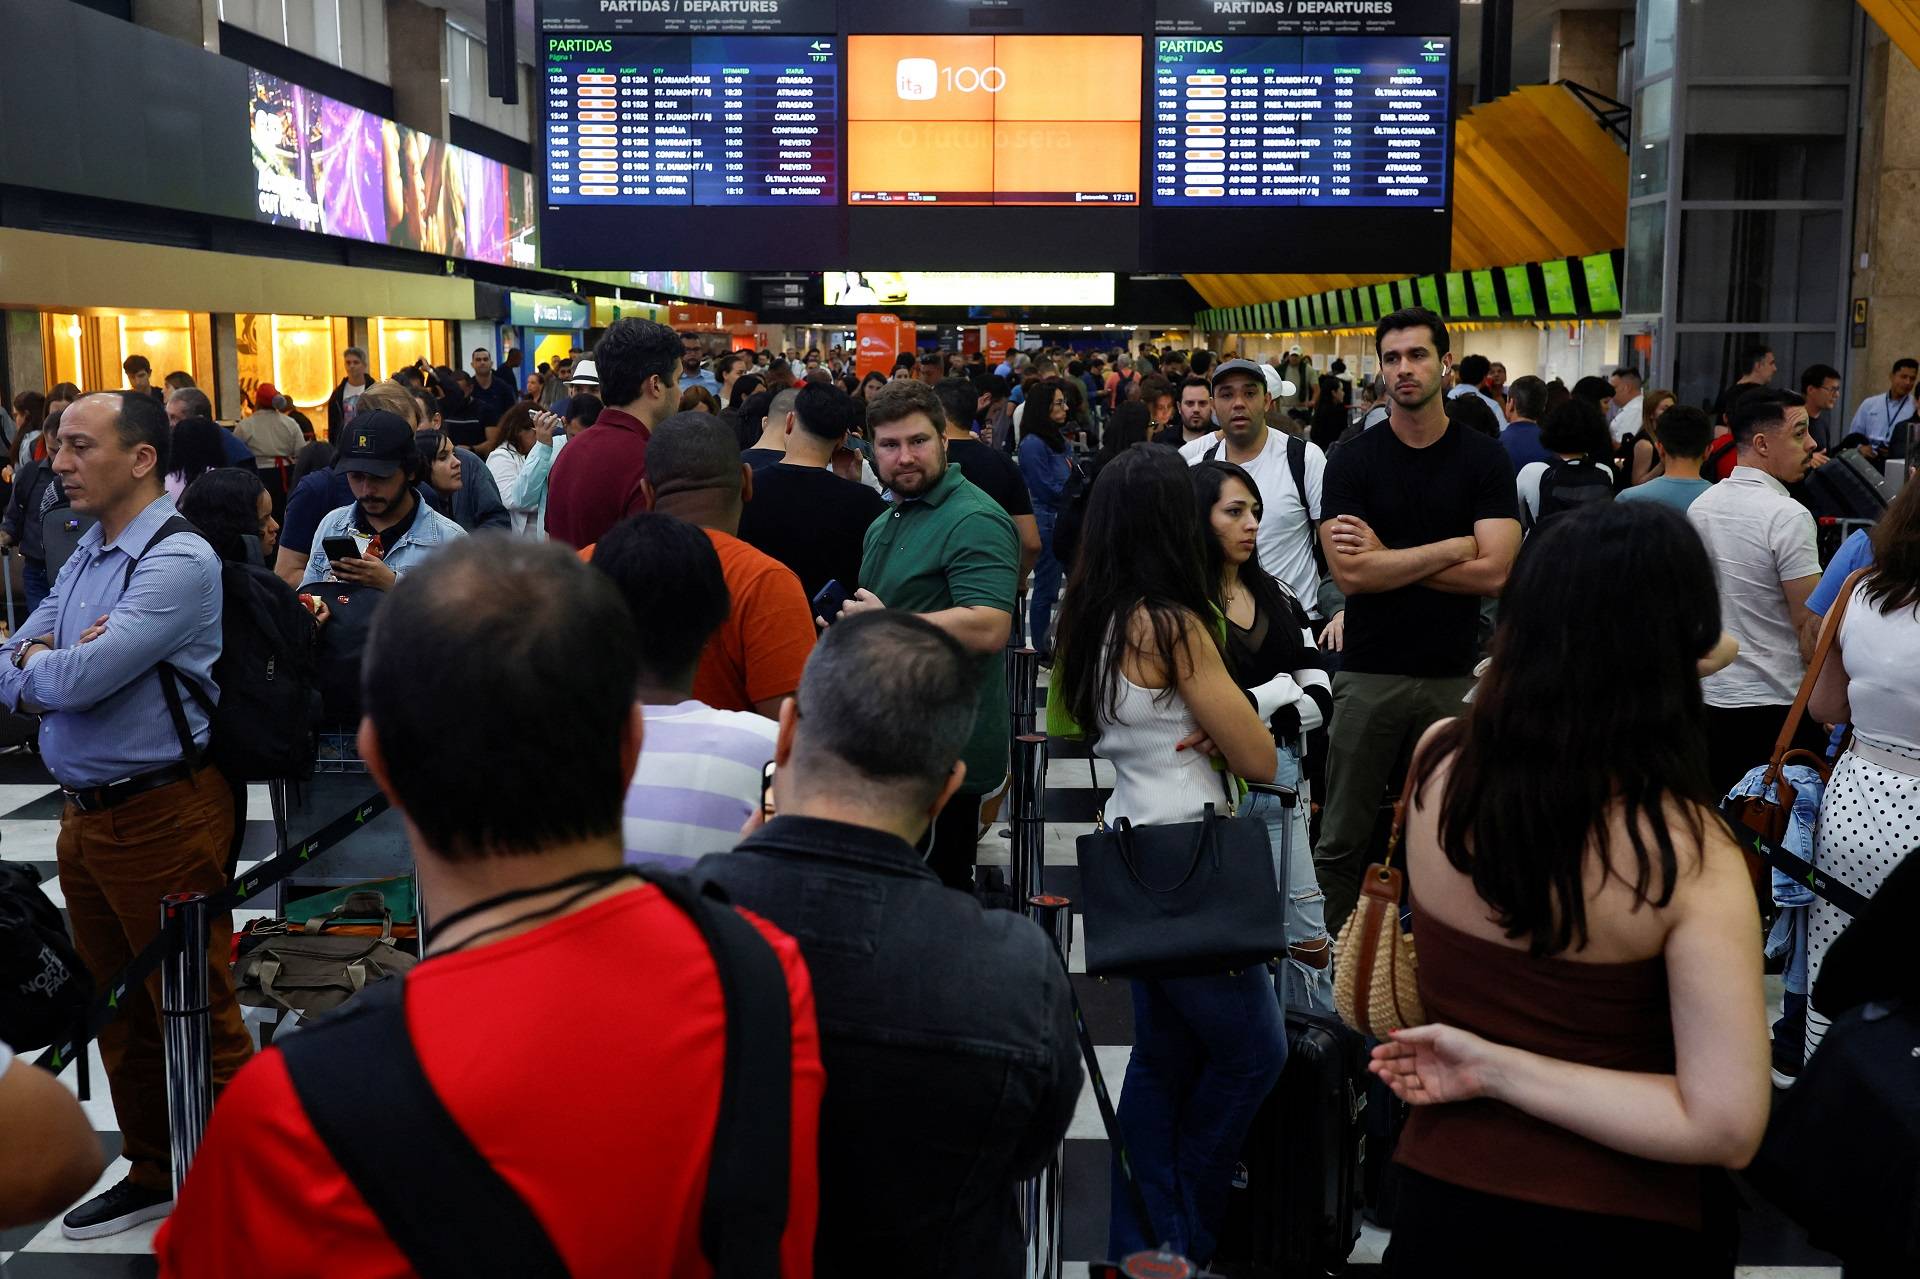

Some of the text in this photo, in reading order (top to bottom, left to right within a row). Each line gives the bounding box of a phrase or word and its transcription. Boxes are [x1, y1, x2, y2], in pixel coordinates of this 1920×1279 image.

[600, 0, 670, 12] PARTIDAS
[683, 0, 778, 13] DEPARTURES
[1213, 2, 1284, 14] PARTIDAS
[1297, 2, 1392, 14] DEPARTURES
[549, 40, 612, 52] PARTIDAS
[1159, 40, 1223, 53] PARTIDAS
[655, 75, 711, 83] FLORIANÓPOLIS
[901, 66, 1006, 95] ita 100
[1276, 76, 1309, 84] DUMONT
[666, 88, 699, 96] DUMONT
[1375, 88, 1402, 96] ÚLTIMA
[1389, 101, 1422, 109] PREVISTO
[655, 125, 686, 134] BRASÍLIA
[1263, 126, 1295, 134] BRASÍLIA
[1374, 126, 1400, 134] ÚLTIMA
[1263, 162, 1294, 171] BRASÍLIA
[765, 174, 791, 182] ÚLTIMA
[1396, 175, 1428, 183] PRÓXIMO
[789, 187, 820, 195] PRÓXIMO
[359, 436, 366, 447] R
[45, 966, 70, 998] FAC
